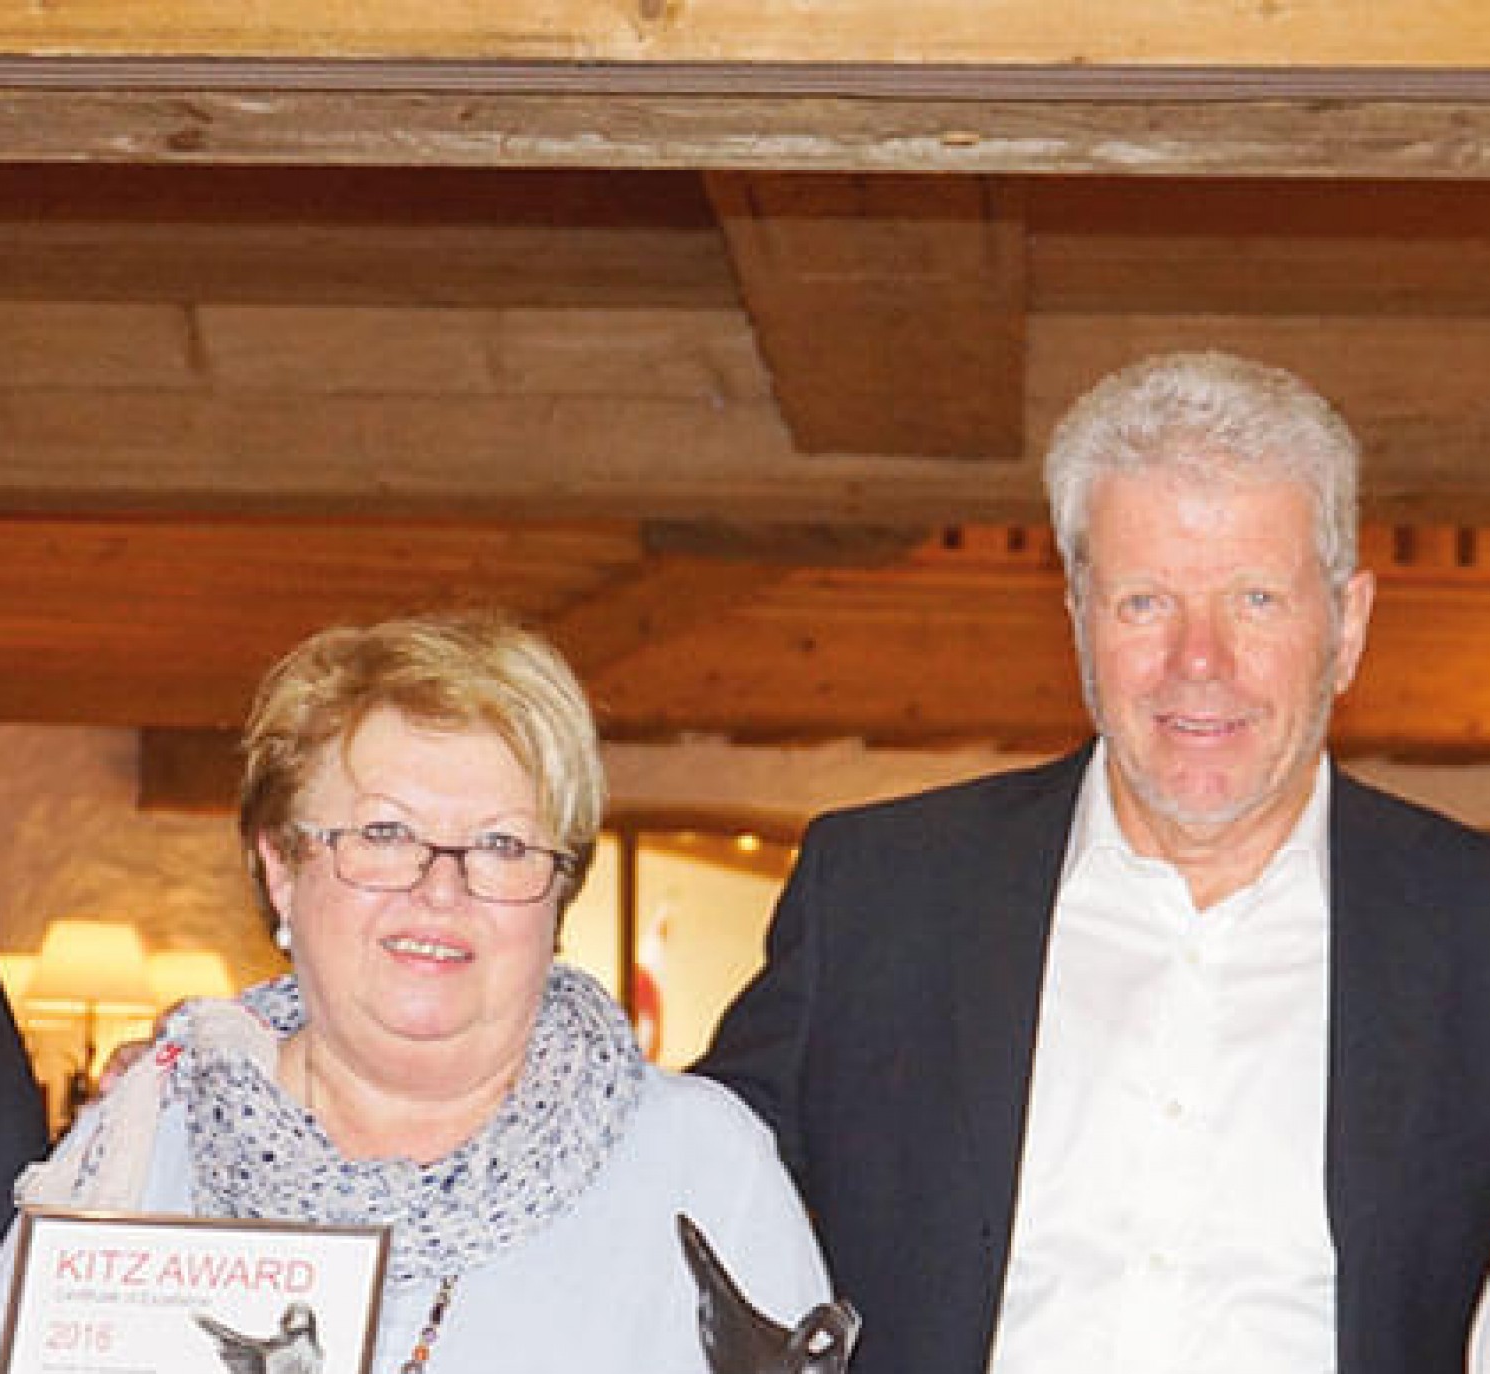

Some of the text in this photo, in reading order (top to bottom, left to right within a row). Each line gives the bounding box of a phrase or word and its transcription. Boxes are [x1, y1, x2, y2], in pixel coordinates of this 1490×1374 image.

[56, 1249, 316, 1293] KITZ AWARD
[46, 1321, 115, 1353] 2016
